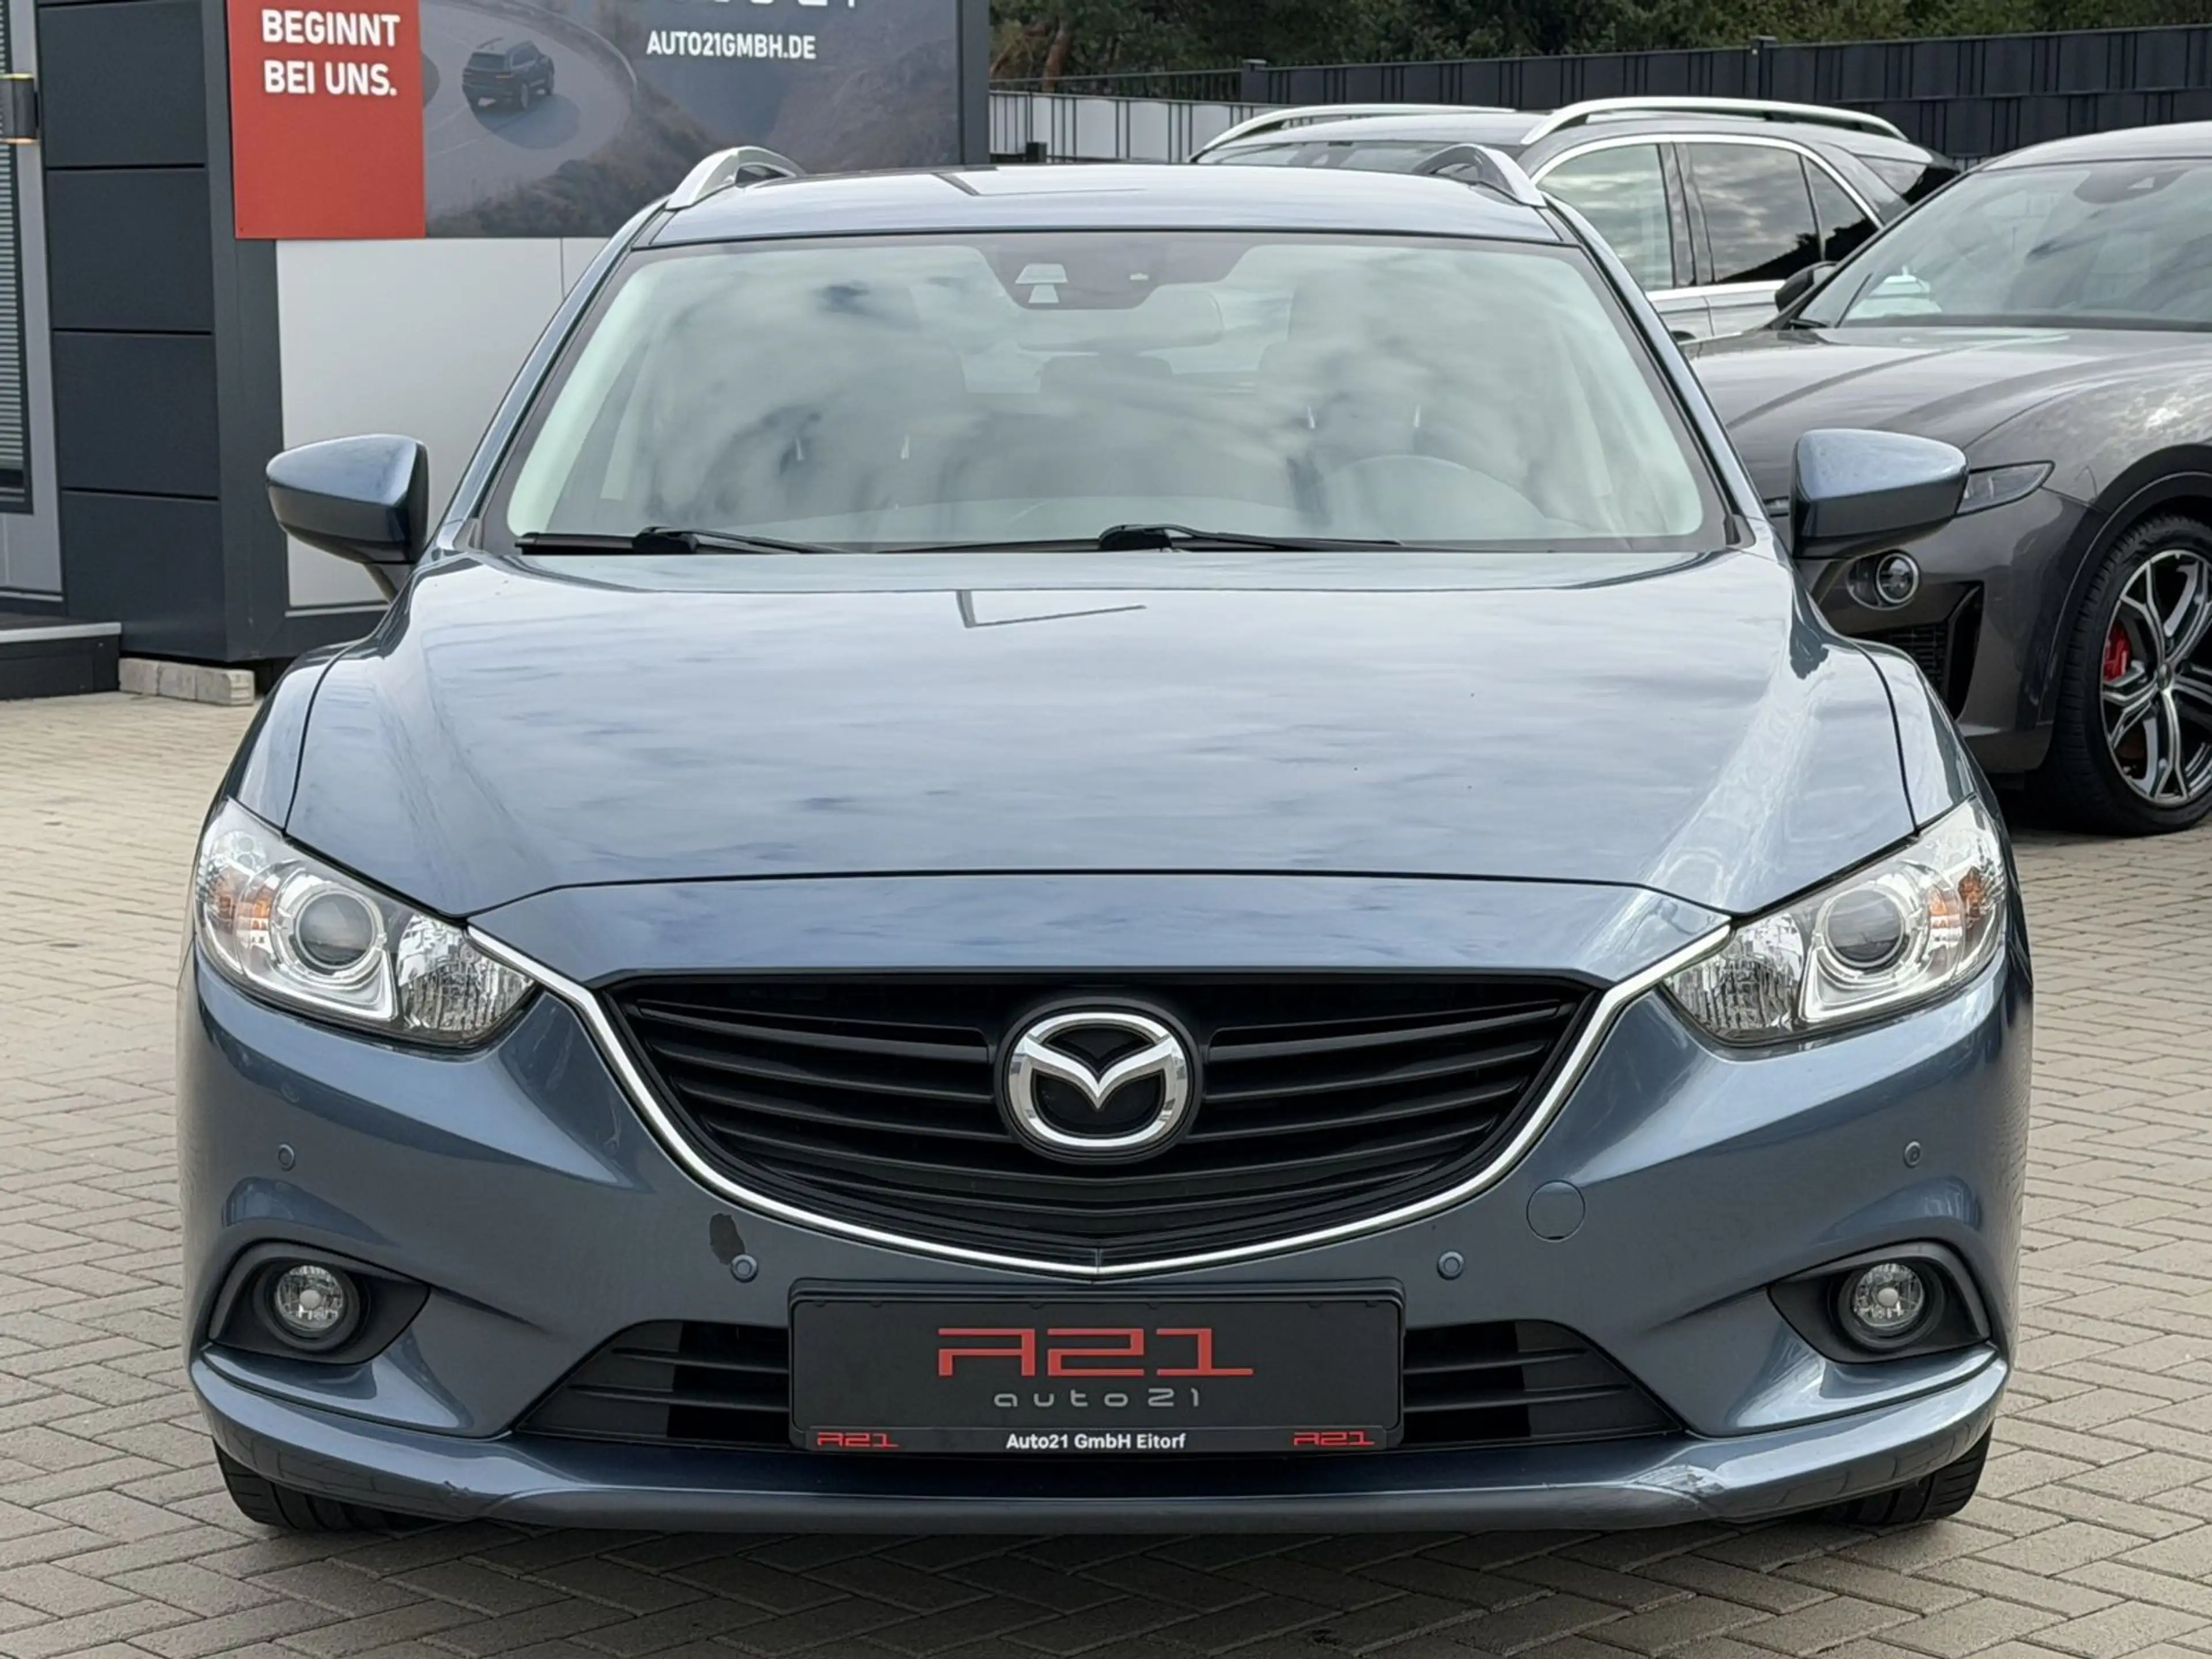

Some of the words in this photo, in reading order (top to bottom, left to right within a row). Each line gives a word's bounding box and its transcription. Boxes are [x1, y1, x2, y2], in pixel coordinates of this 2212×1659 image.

[262, 9, 400, 47] BEGINNT
[646, 29, 817, 59] AUTO21GMBH.DE
[264, 59, 316, 94] BEI
[324, 61, 397, 97] UNS.
[1006, 1433, 1069, 1449] Auto21
[1074, 1433, 1131, 1449] GmbH
[1137, 1433, 1187, 1449] Eitorf
